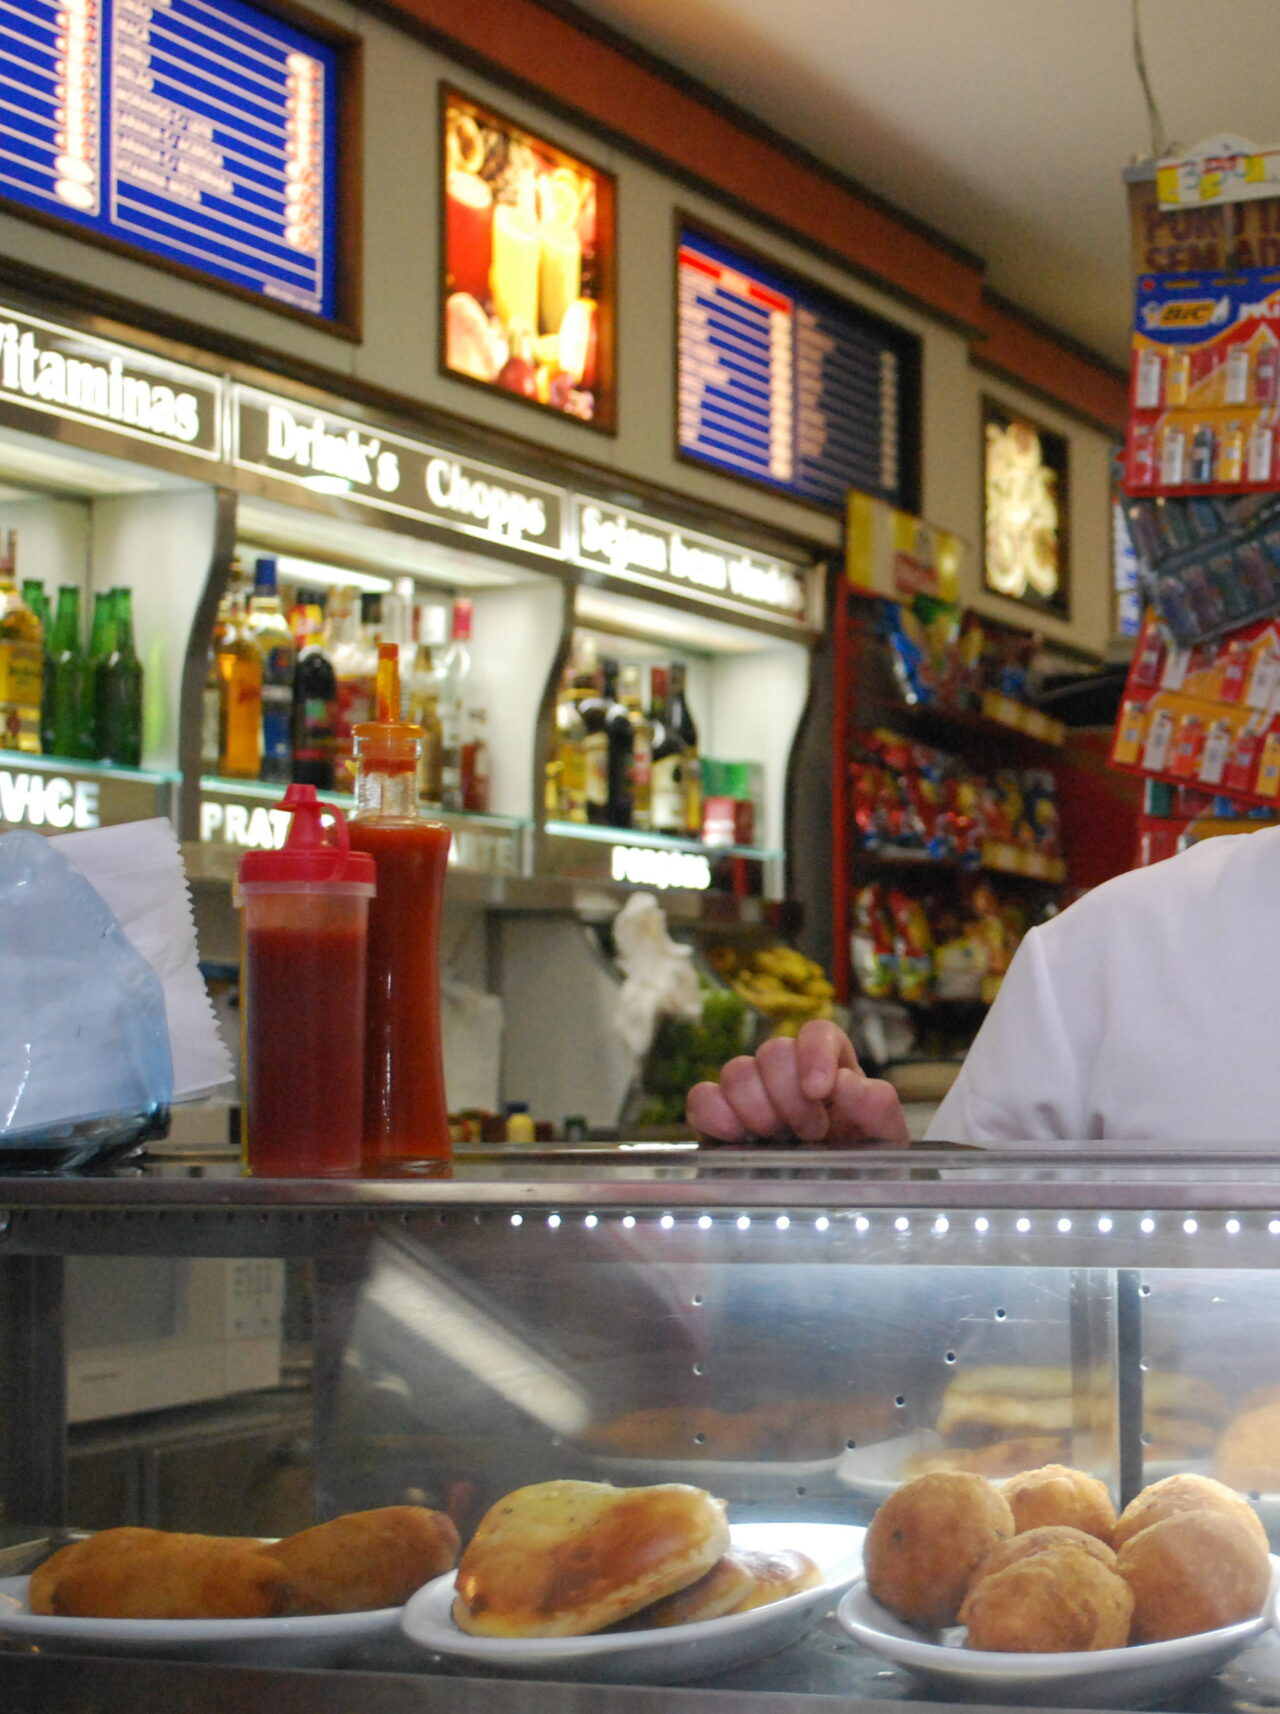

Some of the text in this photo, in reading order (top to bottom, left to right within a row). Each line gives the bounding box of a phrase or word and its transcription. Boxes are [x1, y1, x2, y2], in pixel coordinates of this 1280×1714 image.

[0, 322, 200, 442] itaminas
[425, 458, 547, 539] Chopps
[0, 771, 100, 829] VICE
[200, 802, 336, 850] PRAT
